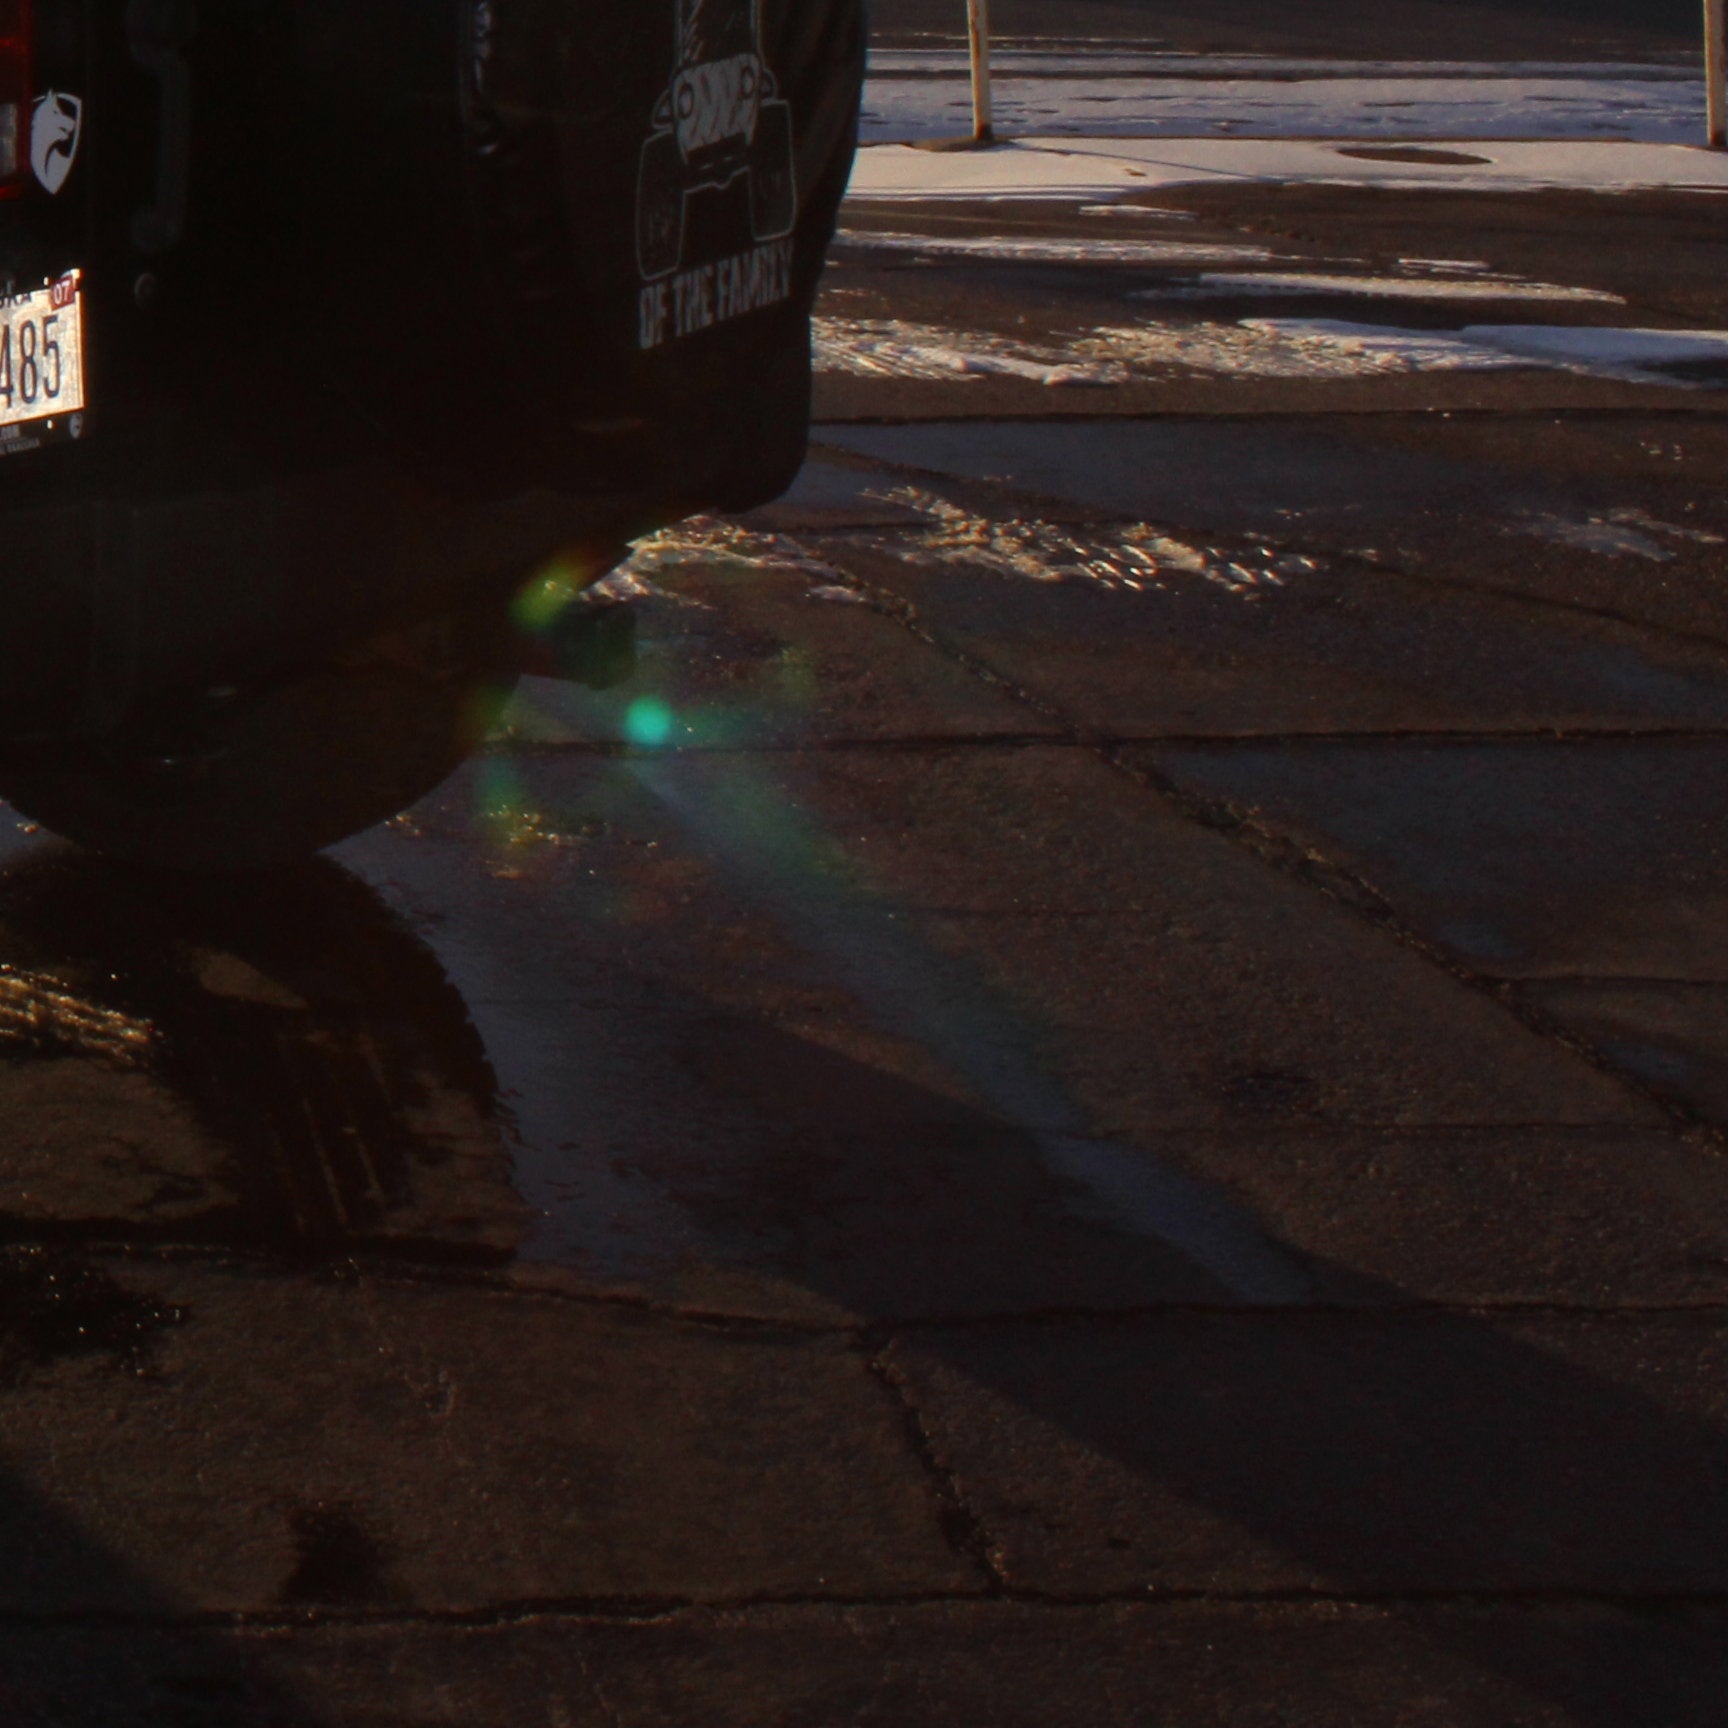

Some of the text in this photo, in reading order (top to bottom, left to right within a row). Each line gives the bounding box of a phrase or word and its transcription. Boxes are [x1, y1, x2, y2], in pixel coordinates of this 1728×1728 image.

[52, 280, 71, 306] 07
[638, 239, 794, 350] OF THE FAMILY
